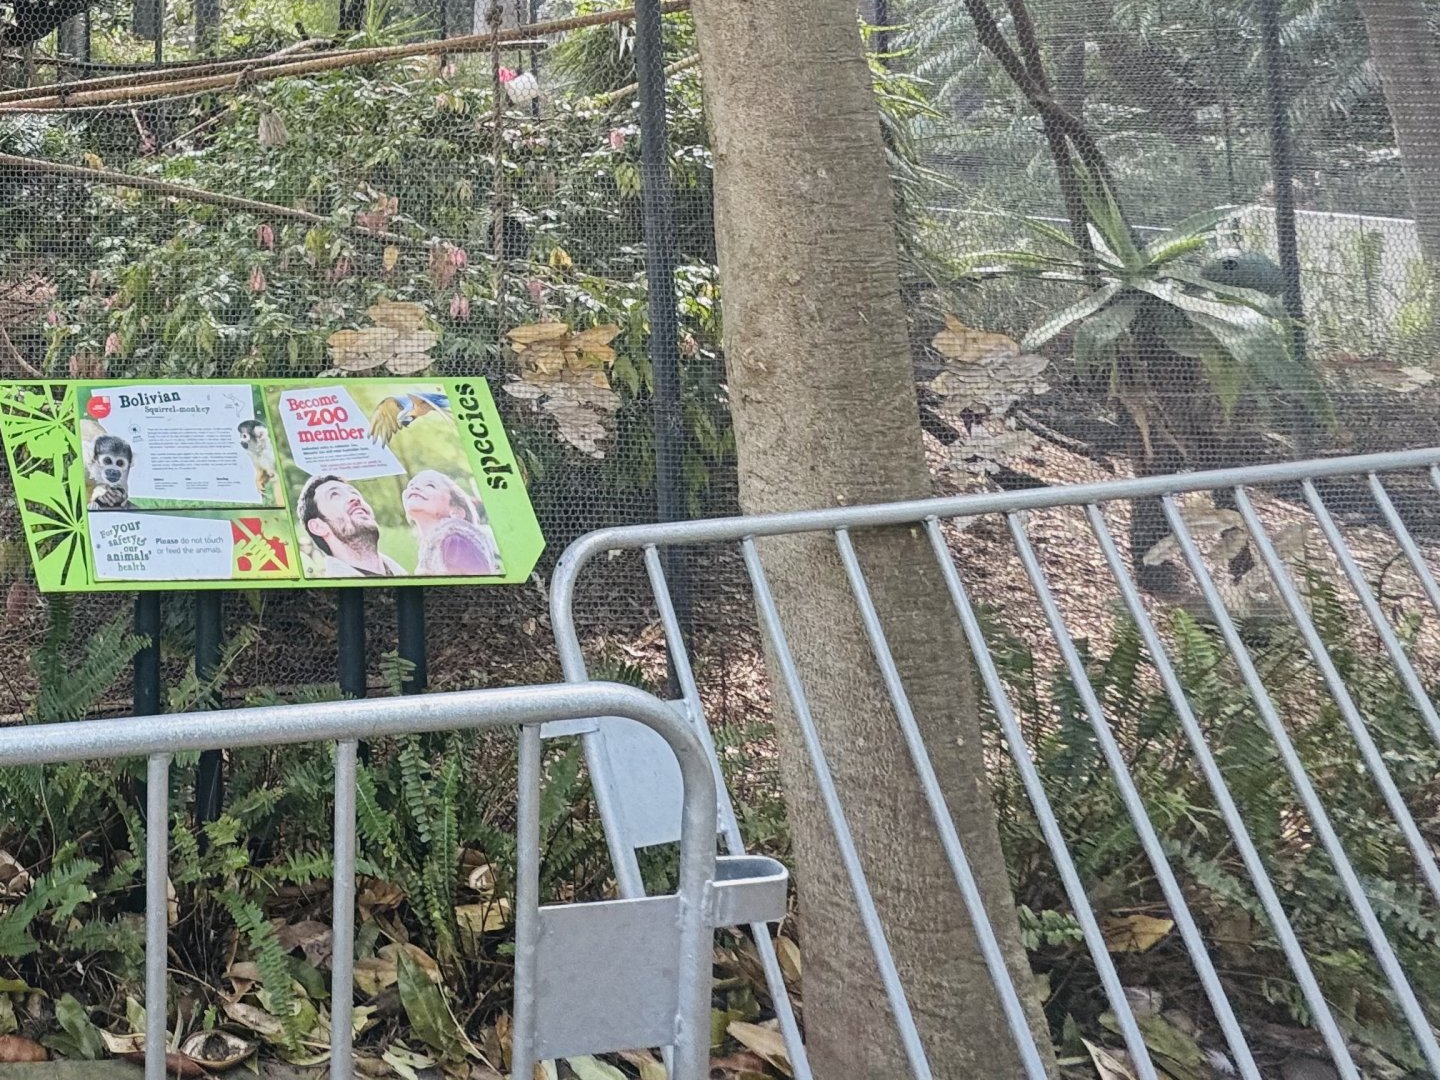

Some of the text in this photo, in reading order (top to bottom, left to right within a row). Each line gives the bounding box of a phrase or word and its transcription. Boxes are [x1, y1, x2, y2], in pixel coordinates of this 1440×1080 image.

[118, 391, 181, 408] Bolivian
[286, 395, 339, 411] Become
[296, 407, 349, 426] a ZOO
[297, 423, 365, 442] member
[455, 383, 513, 490] species
[100, 521, 141, 539] For your
[204, 536, 224, 544] touch
[107, 550, 152, 561] animals'
[118, 562, 146, 571] health
